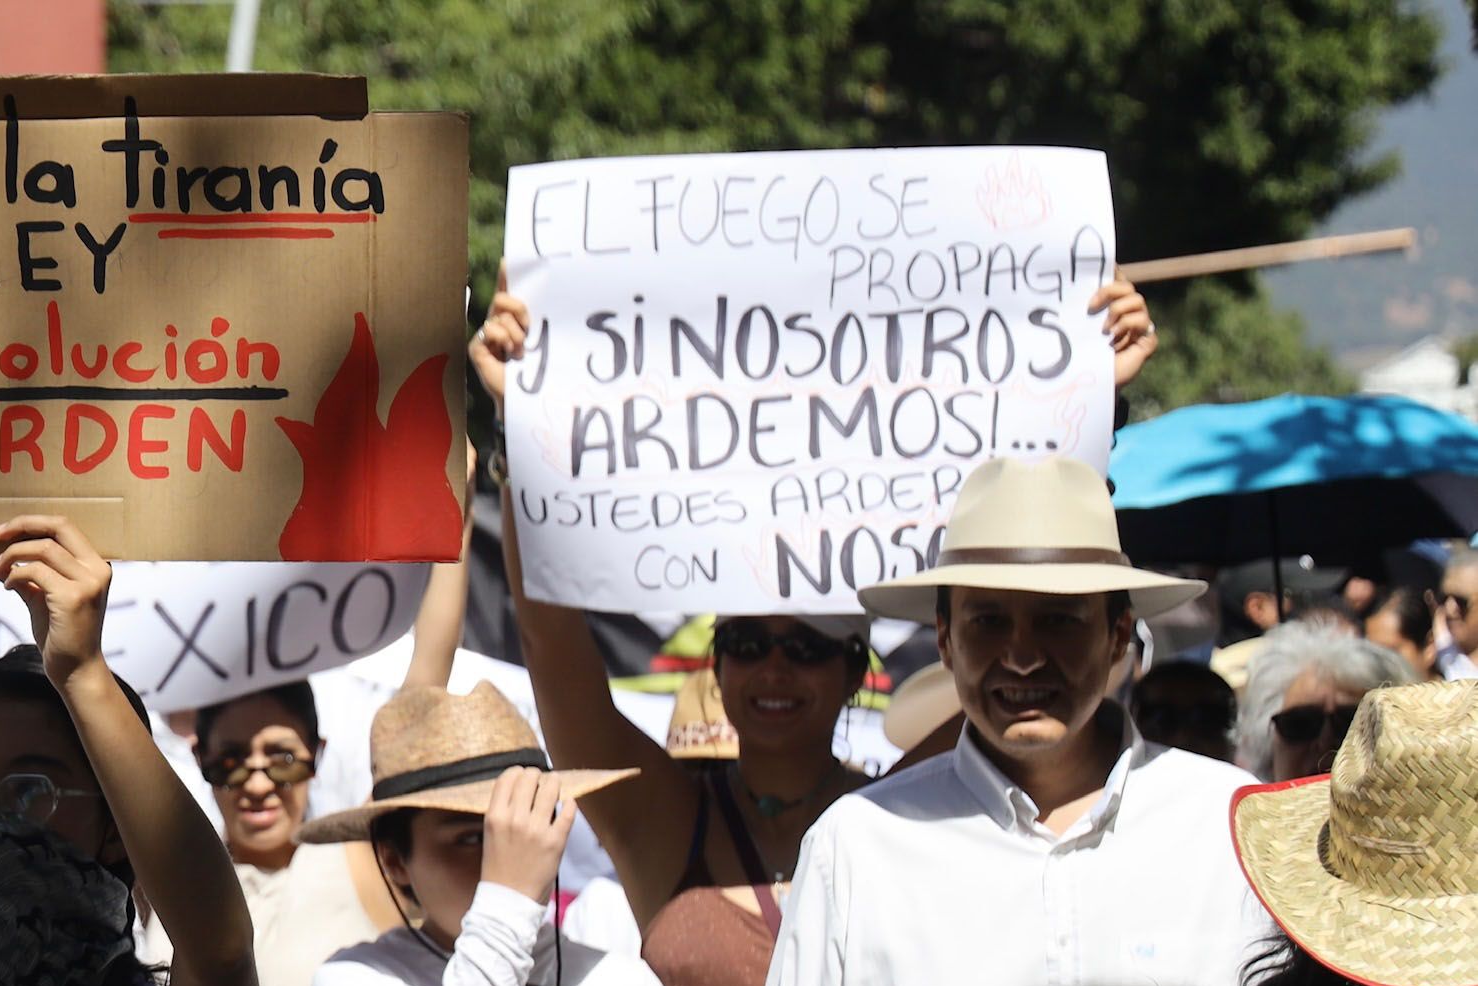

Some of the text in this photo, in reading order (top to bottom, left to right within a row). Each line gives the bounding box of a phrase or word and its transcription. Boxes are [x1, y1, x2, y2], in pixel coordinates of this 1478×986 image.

[3, 94, 77, 208] la
[102, 96, 385, 214] tiranía
[532, 173, 937, 262] EL FUEGO SE
[829, 223, 1106, 309] PROPAGA
[520, 487, 748, 533] USTEDES
[633, 543, 719, 592] CON
